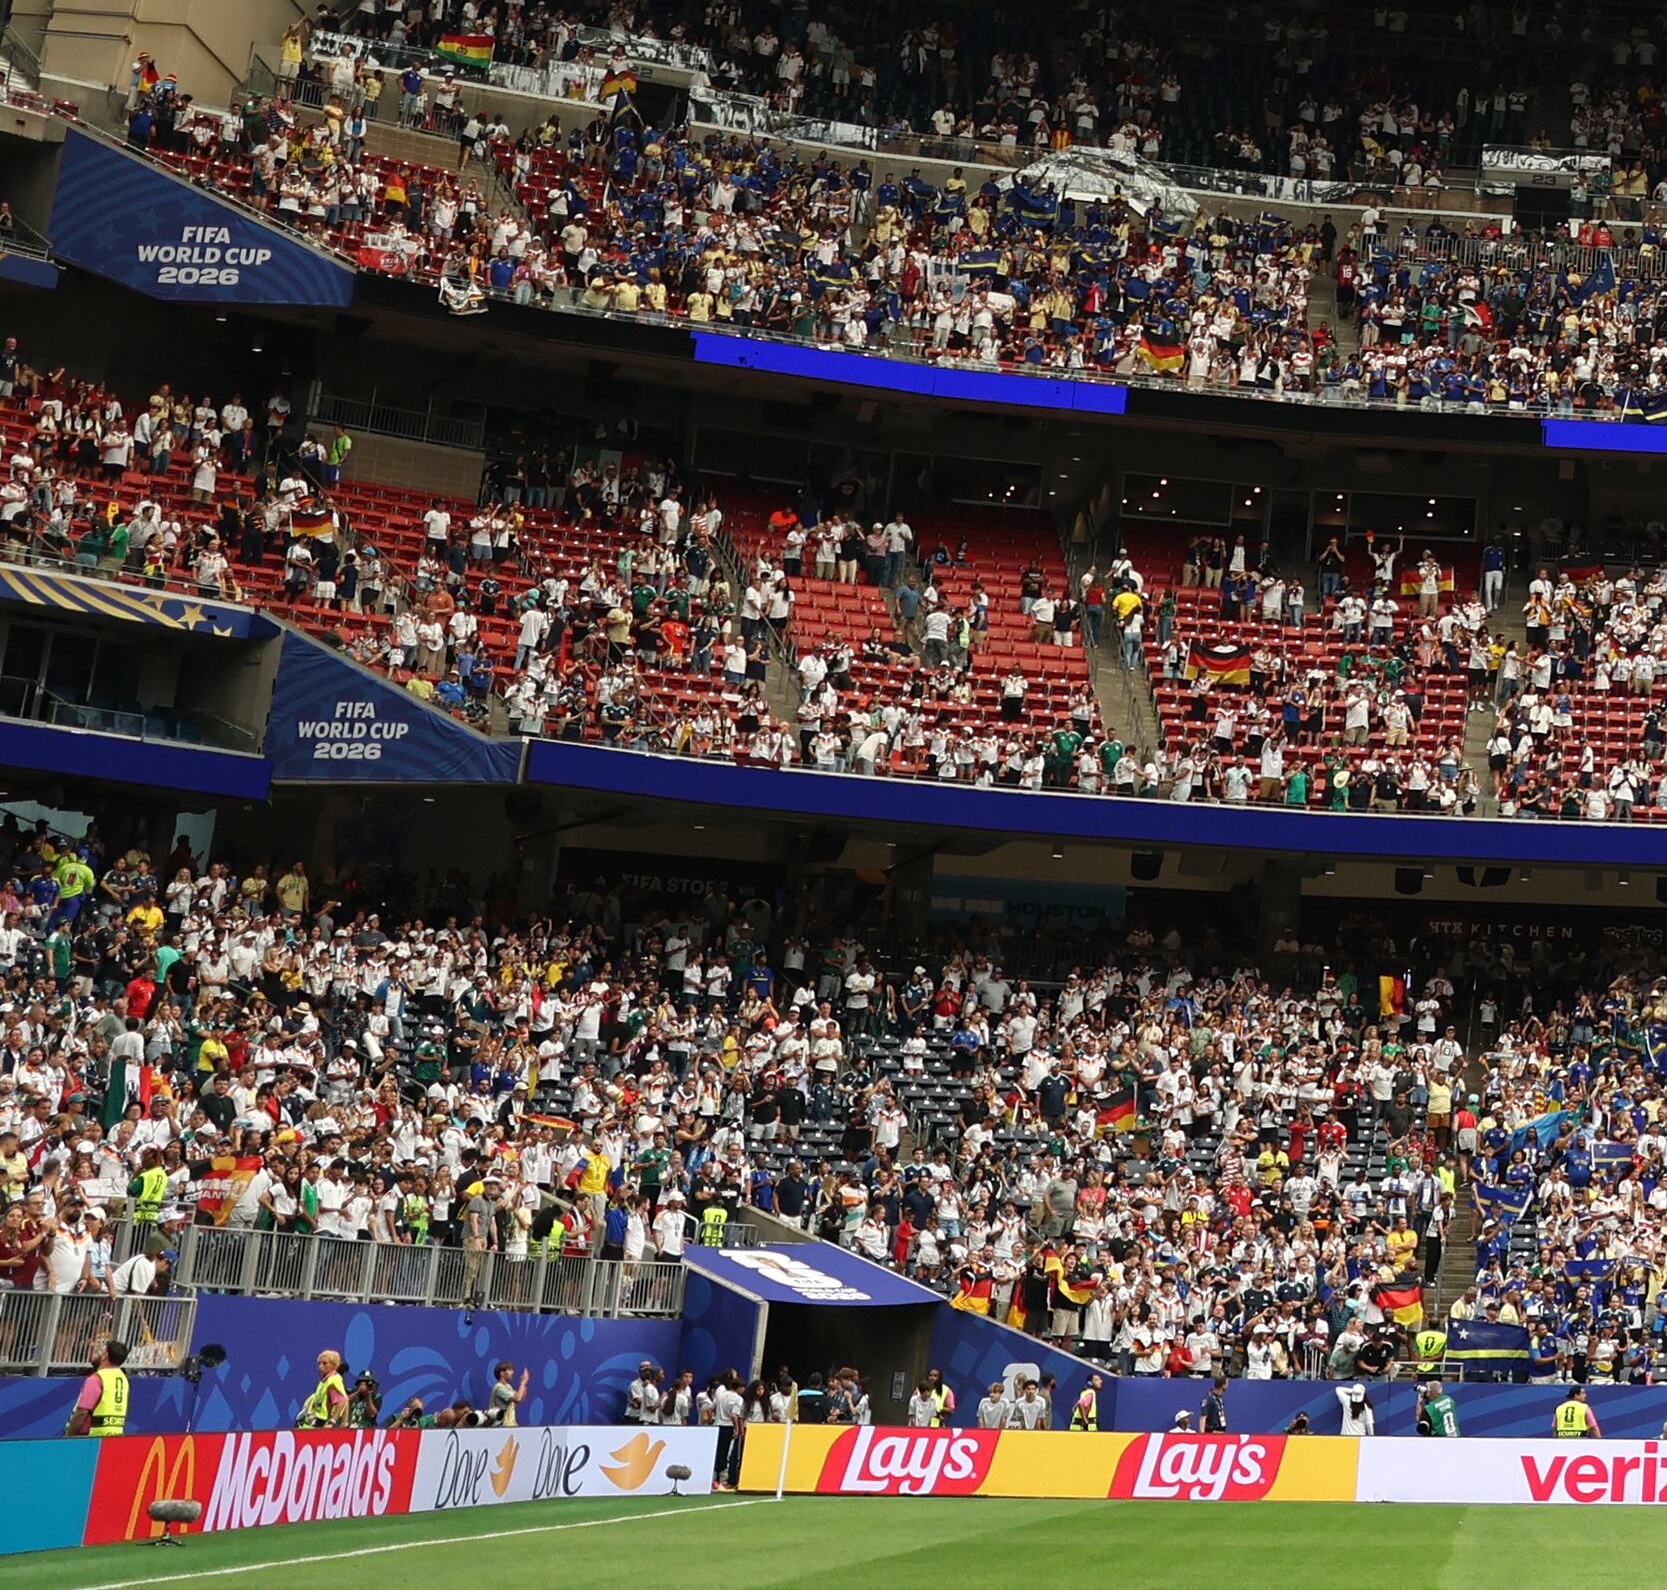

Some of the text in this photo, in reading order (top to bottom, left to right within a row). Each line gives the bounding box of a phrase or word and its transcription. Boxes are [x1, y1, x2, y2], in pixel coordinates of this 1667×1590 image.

[1532, 174, 1556, 186] 23
[181, 224, 231, 245] FIFA
[138, 245, 272, 267] WORLD CUP
[157, 265, 240, 286] 2026
[334, 700, 376, 719] FIFA
[298, 722, 409, 741] WORLD CUP
[313, 741, 382, 761] 2026
[1470, 922, 1574, 939] KITCHEN
[840, 1425, 978, 1496] Lay's
[1132, 1432, 1264, 1501] Lay's
[203, 1430, 398, 1533] McDonald's
[435, 1430, 490, 1508] Dove
[532, 1426, 590, 1500] Dove
